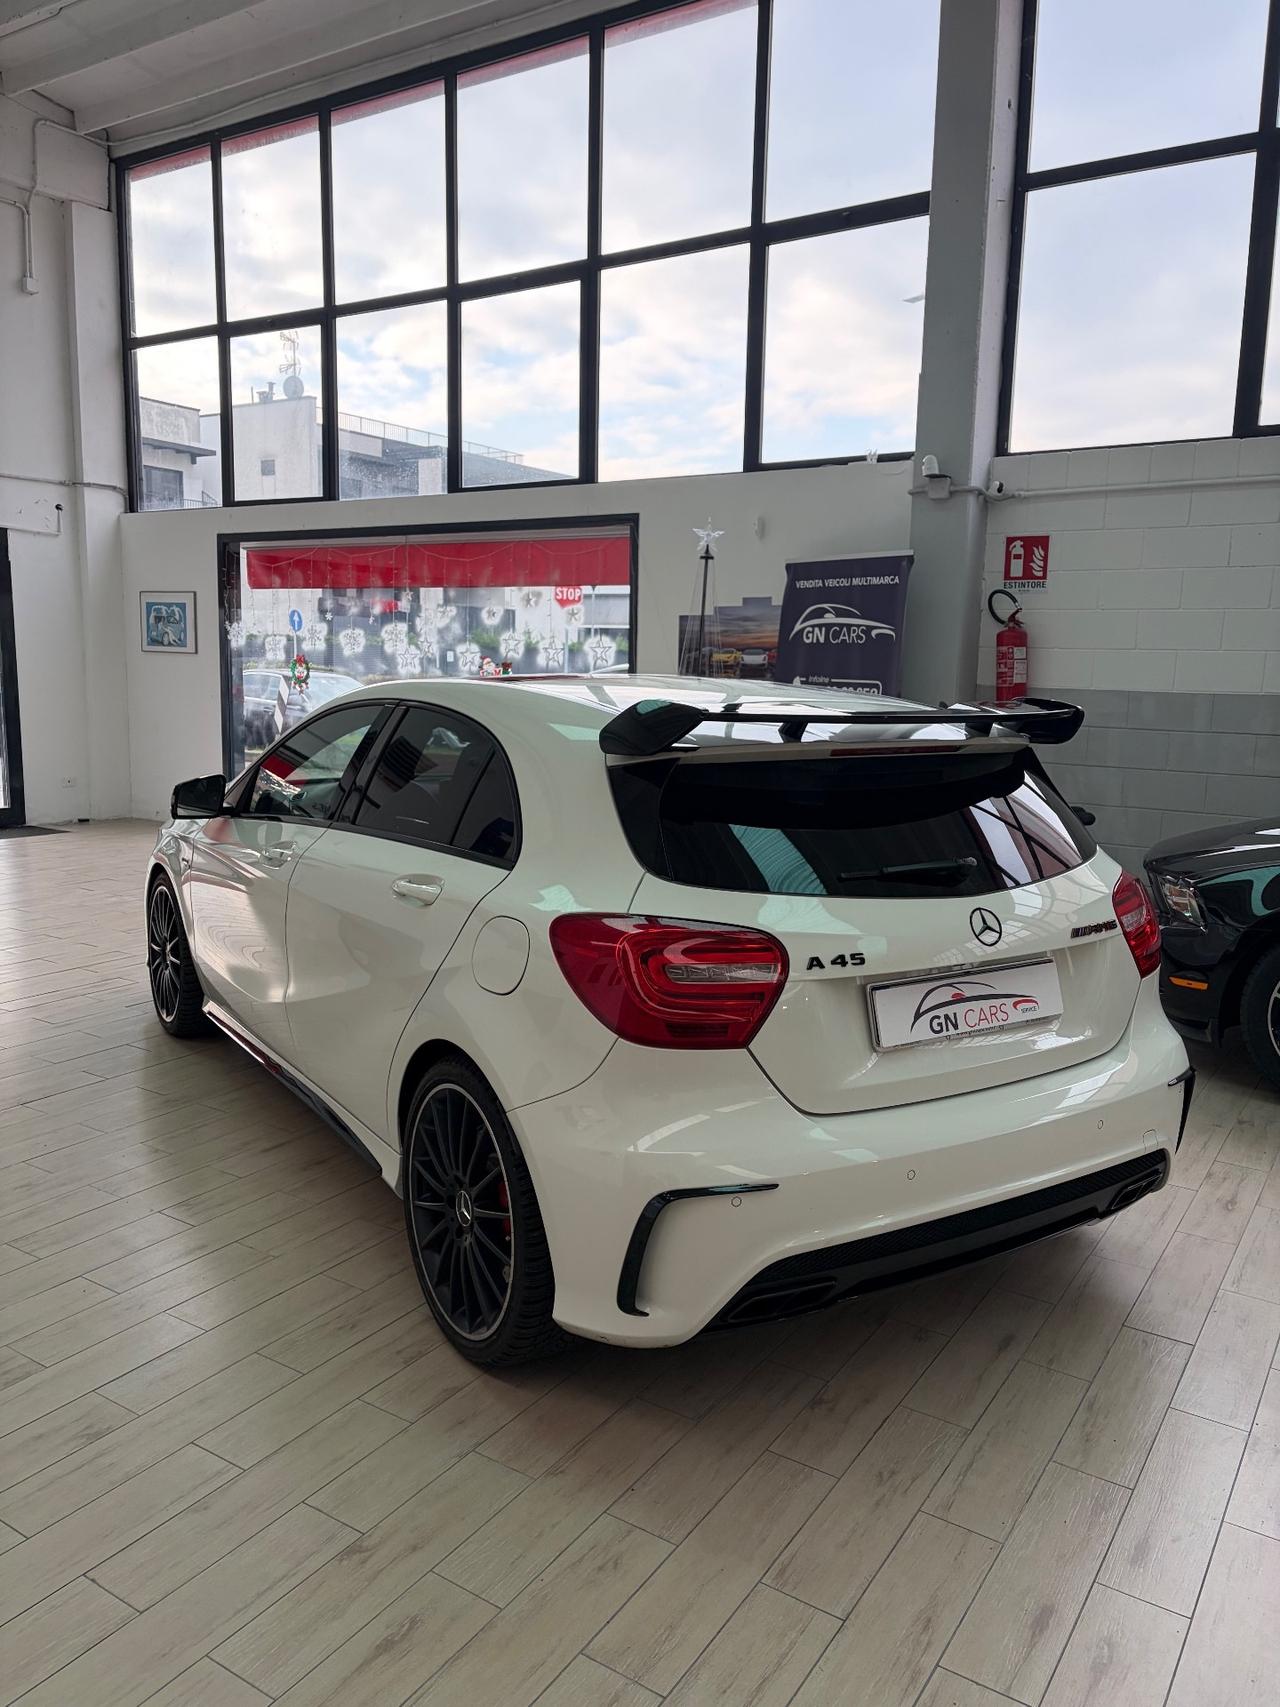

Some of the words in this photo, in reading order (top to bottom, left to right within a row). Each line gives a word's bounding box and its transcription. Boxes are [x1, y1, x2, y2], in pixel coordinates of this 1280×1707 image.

[795, 579, 823, 589] VENDITA
[825, 577, 851, 587] VEICOLI
[851, 575, 900, 586] MULTIMARCA
[1003, 581, 1047, 590] ESTINTORE
[556, 588, 581, 601] STOP
[803, 627, 825, 644] GN
[829, 626, 866, 644] CARS
[806, 956, 826, 971] A
[830, 953, 866, 968] 45
[929, 1012, 959, 1035] GN
[964, 1003, 1009, 1028] CARS
